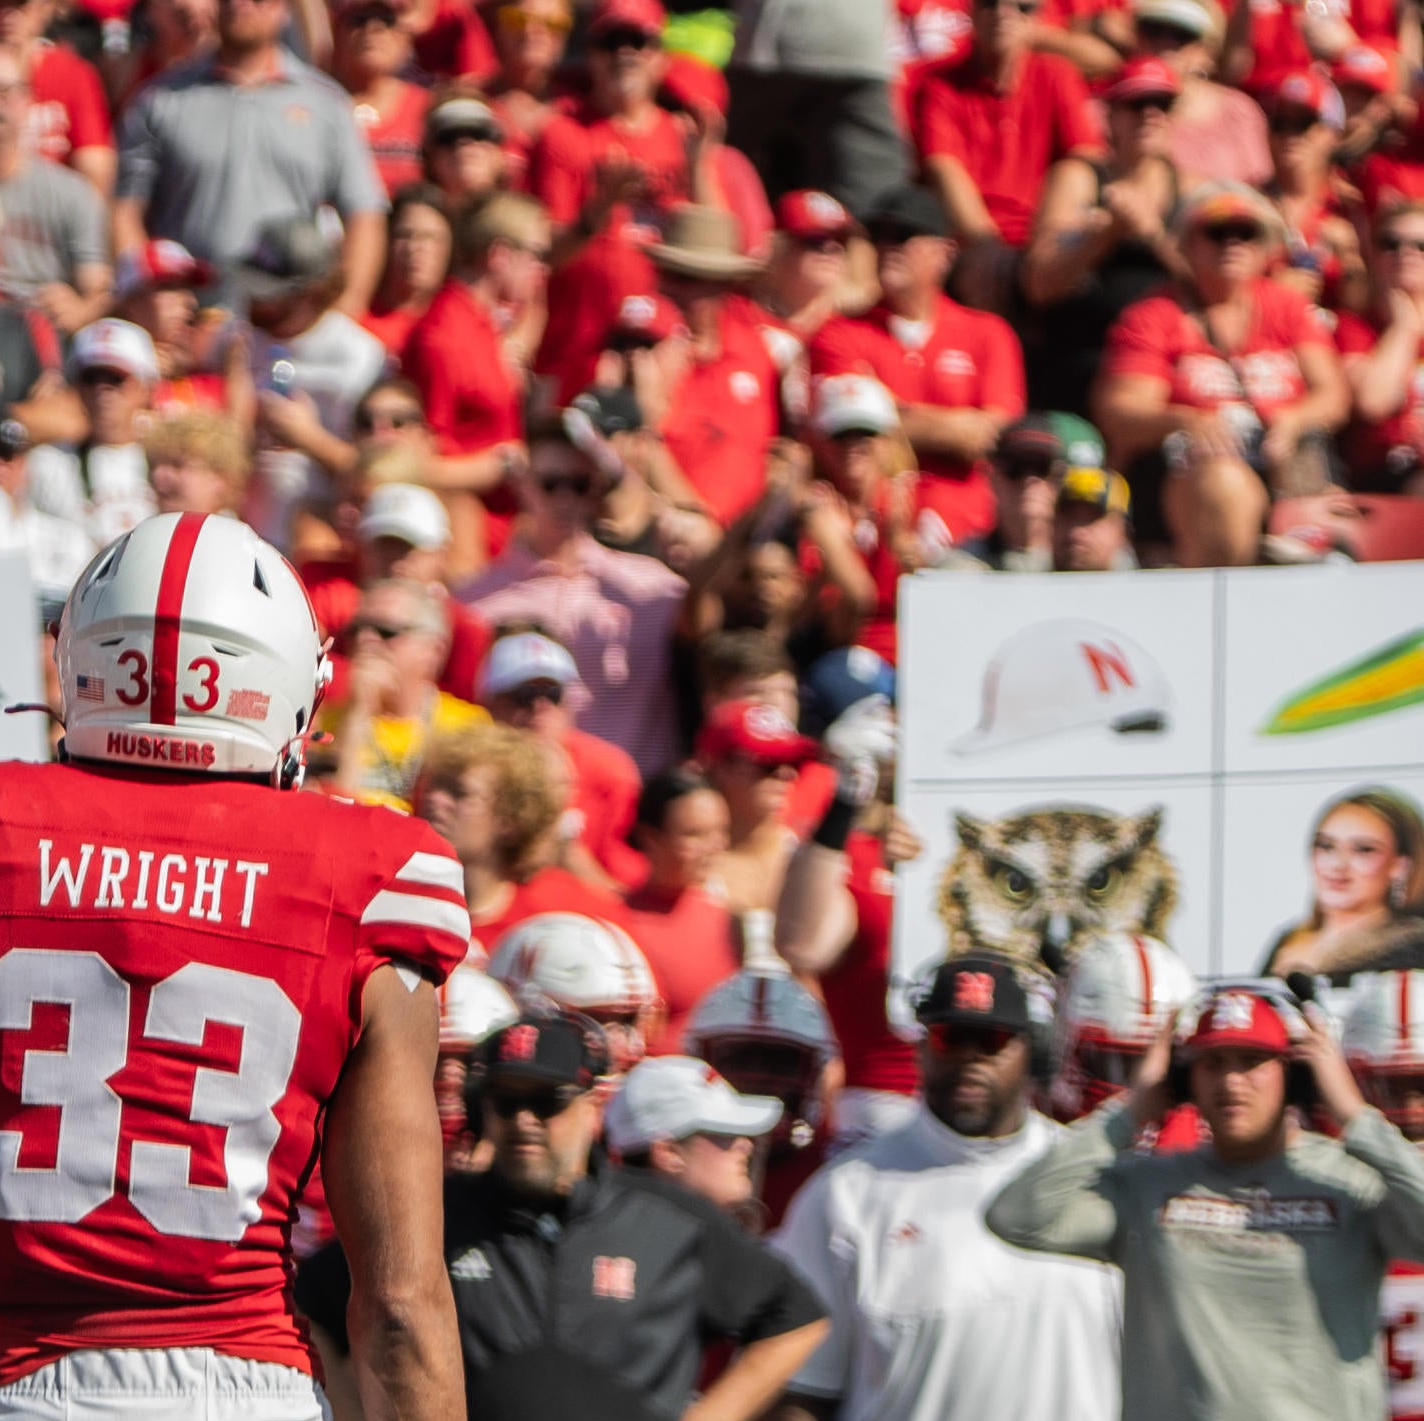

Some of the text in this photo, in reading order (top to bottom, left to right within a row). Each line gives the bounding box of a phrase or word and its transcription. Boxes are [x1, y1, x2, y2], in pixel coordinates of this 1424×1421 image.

[116, 649, 220, 714] 33
[1079, 640, 1135, 693] N
[106, 731, 216, 767] HUSKERS
[37, 838, 269, 928] WRIGHT
